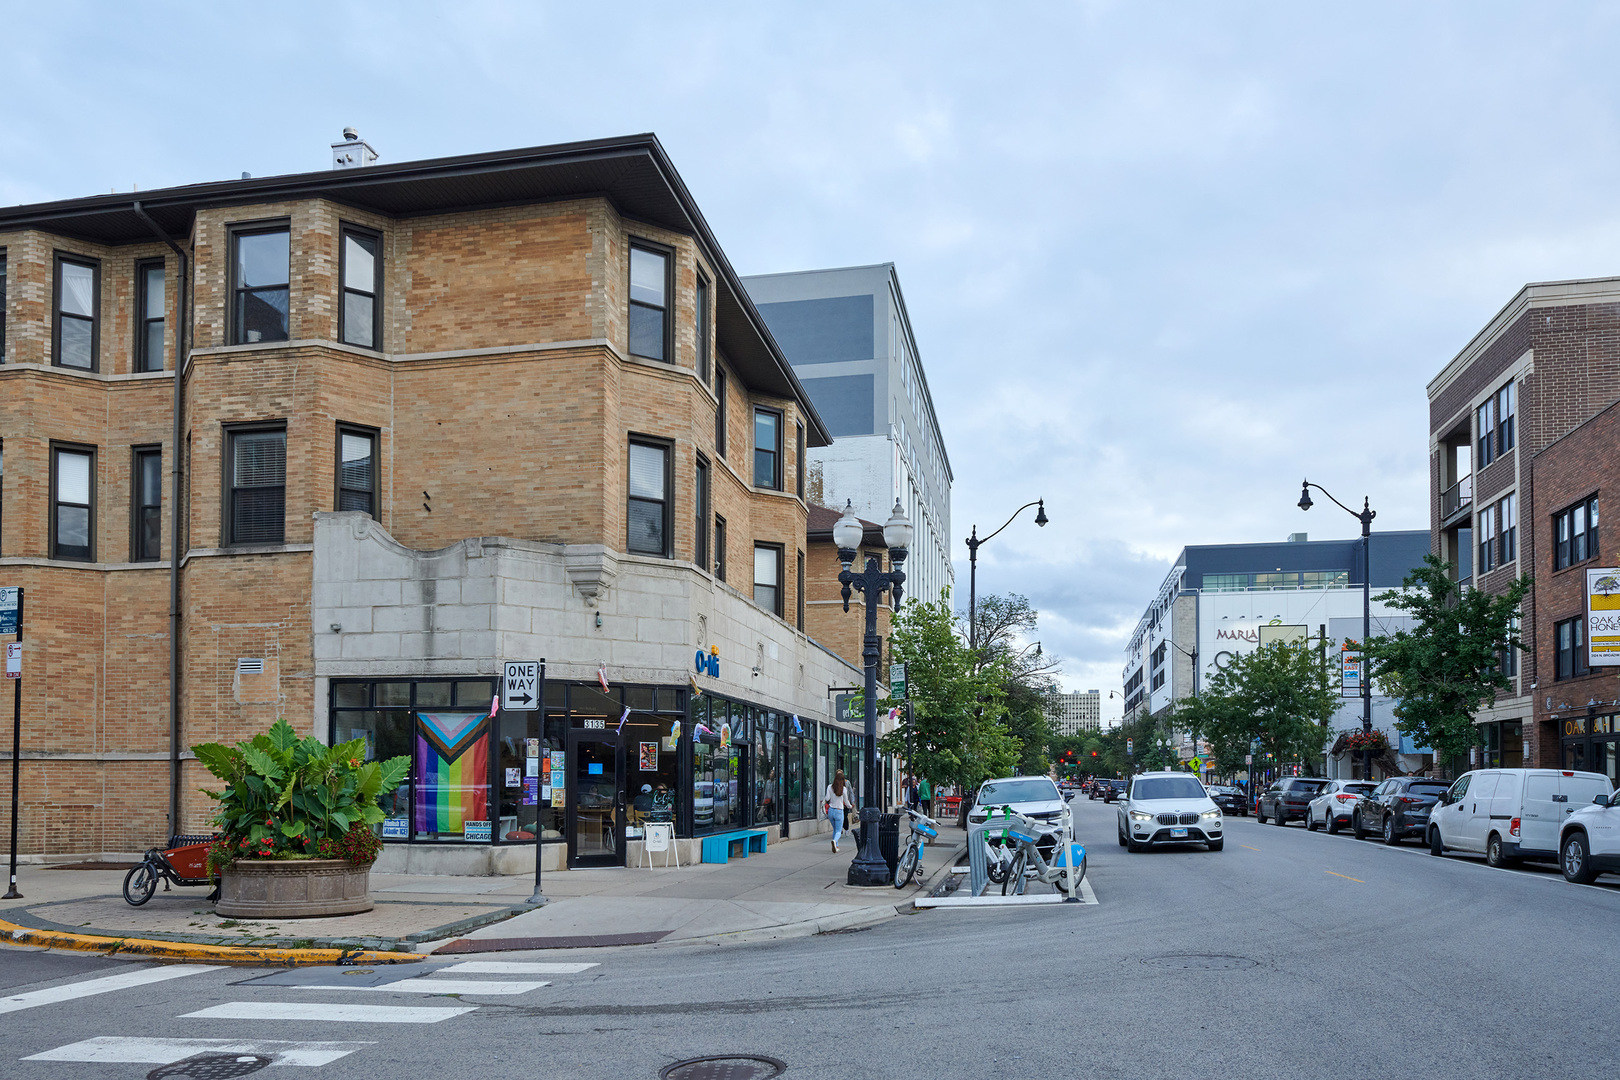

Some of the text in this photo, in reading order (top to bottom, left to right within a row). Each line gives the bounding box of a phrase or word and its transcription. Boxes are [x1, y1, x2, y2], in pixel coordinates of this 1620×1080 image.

[1590, 616, 1613, 624] OAK
[1591, 623, 1620, 631] HONE
[1216, 629, 1259, 643] MARIA
[508, 665, 534, 677] ONE
[507, 679, 535, 690] WAY
[584, 720, 605, 729] 3135
